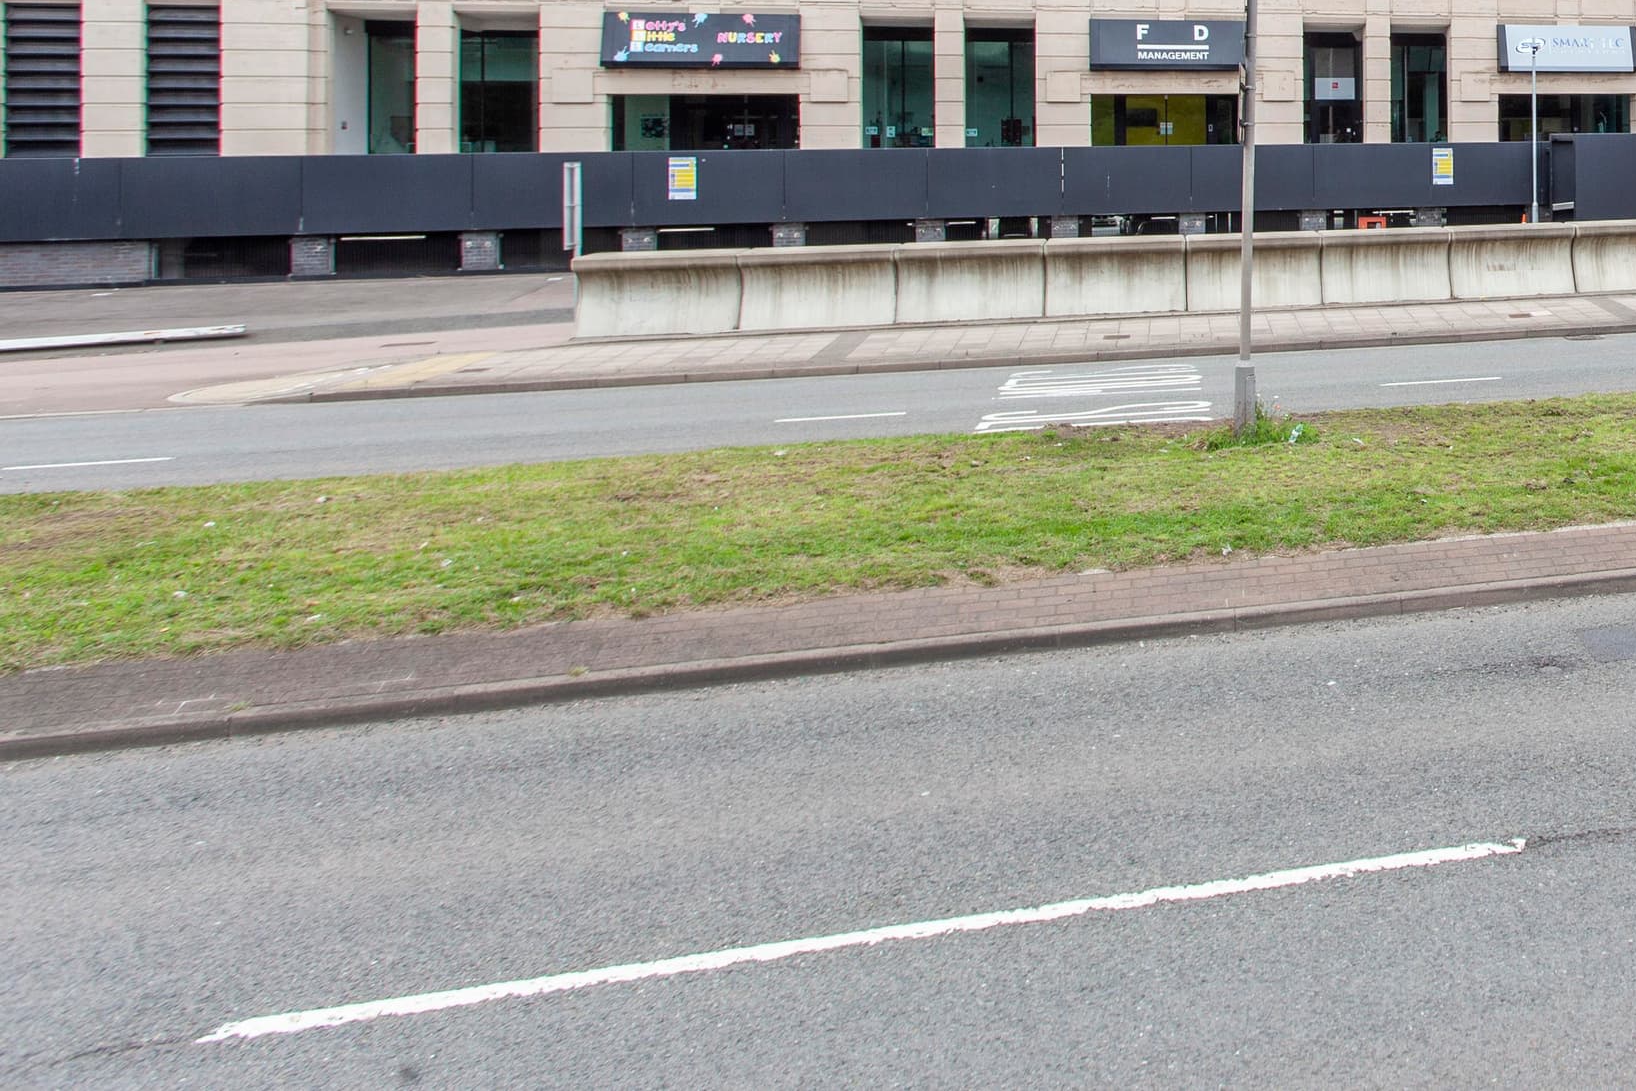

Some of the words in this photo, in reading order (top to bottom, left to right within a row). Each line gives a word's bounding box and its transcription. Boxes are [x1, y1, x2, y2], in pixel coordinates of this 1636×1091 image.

[717, 32, 783, 44] NURSERY
[1136, 24, 1149, 40] F
[1193, 25, 1209, 41] D
[1137, 51, 1209, 60] MANAGEMENT
